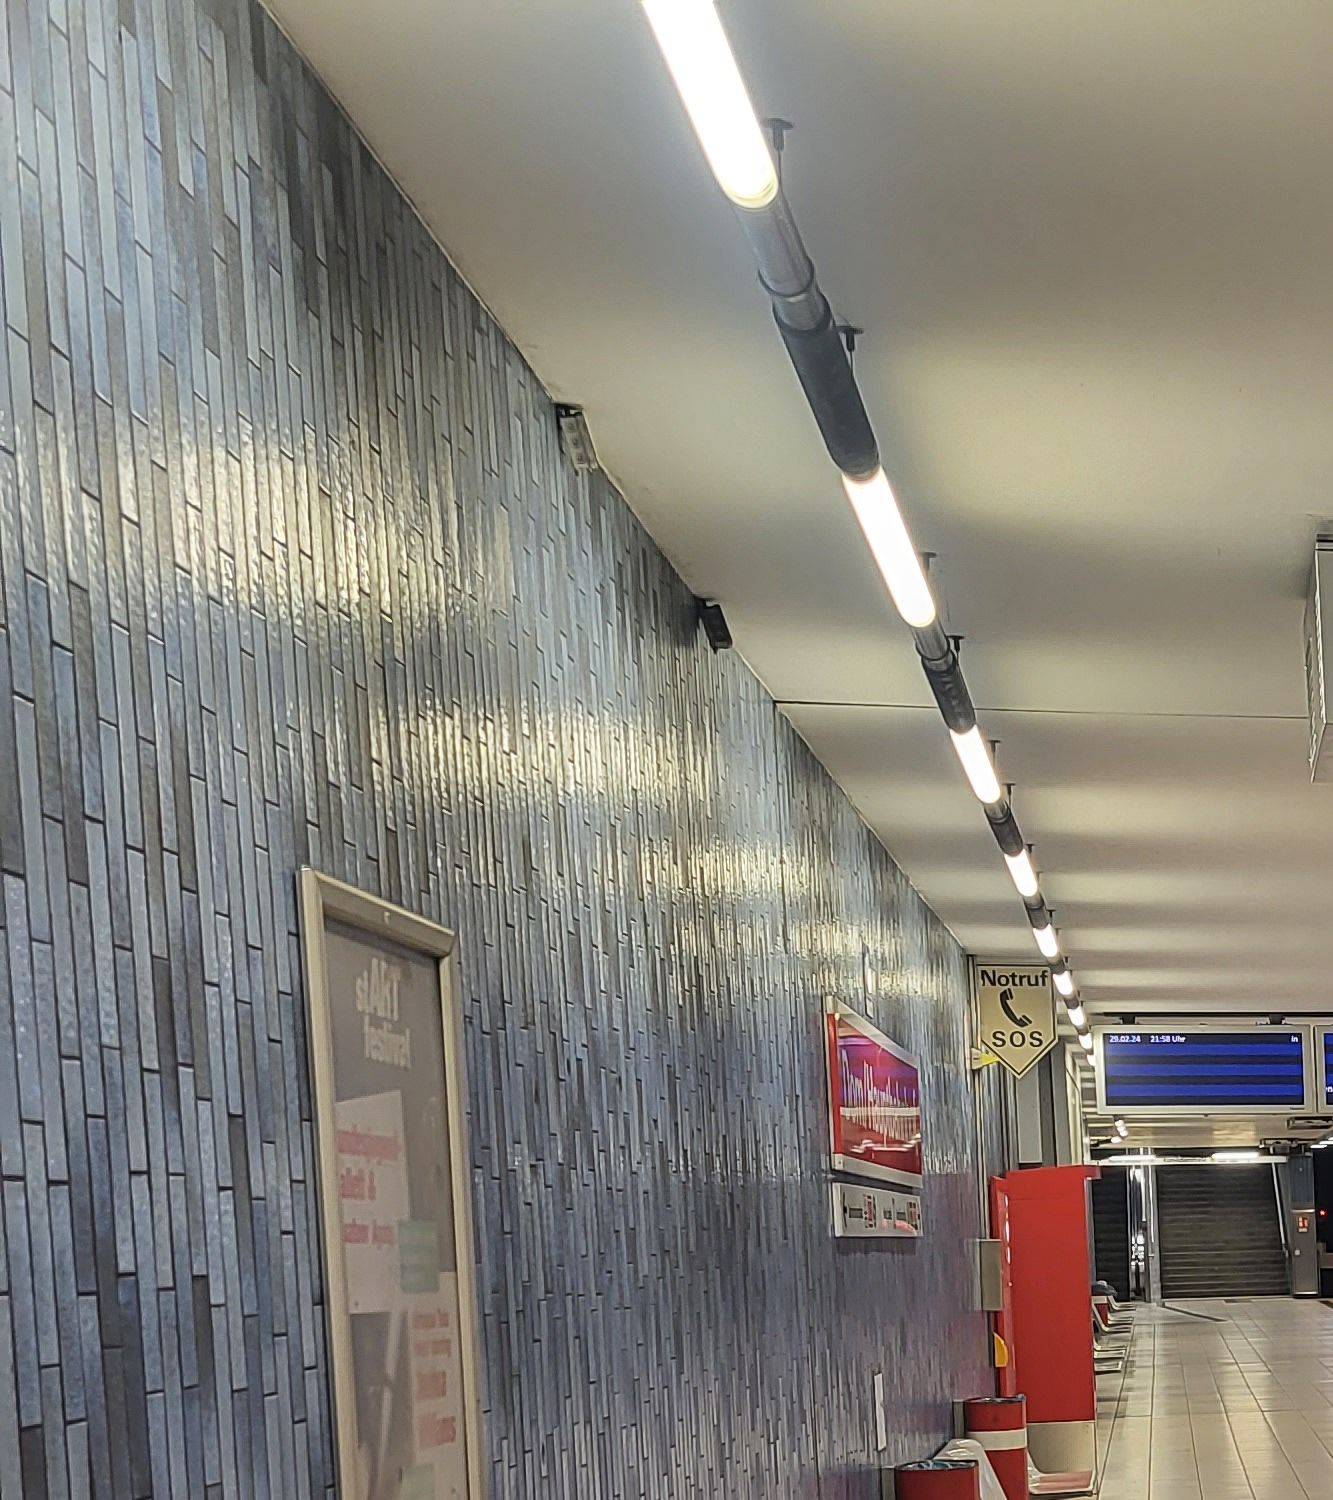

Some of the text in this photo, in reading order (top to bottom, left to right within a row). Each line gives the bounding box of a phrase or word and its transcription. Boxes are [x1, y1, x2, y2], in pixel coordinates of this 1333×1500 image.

[980, 969, 1049, 987] Notruf
[992, 1030, 1043, 1048] SOS
[1172, 1035, 1186, 1043] Uhr
[1291, 1035, 1298, 1043] in
